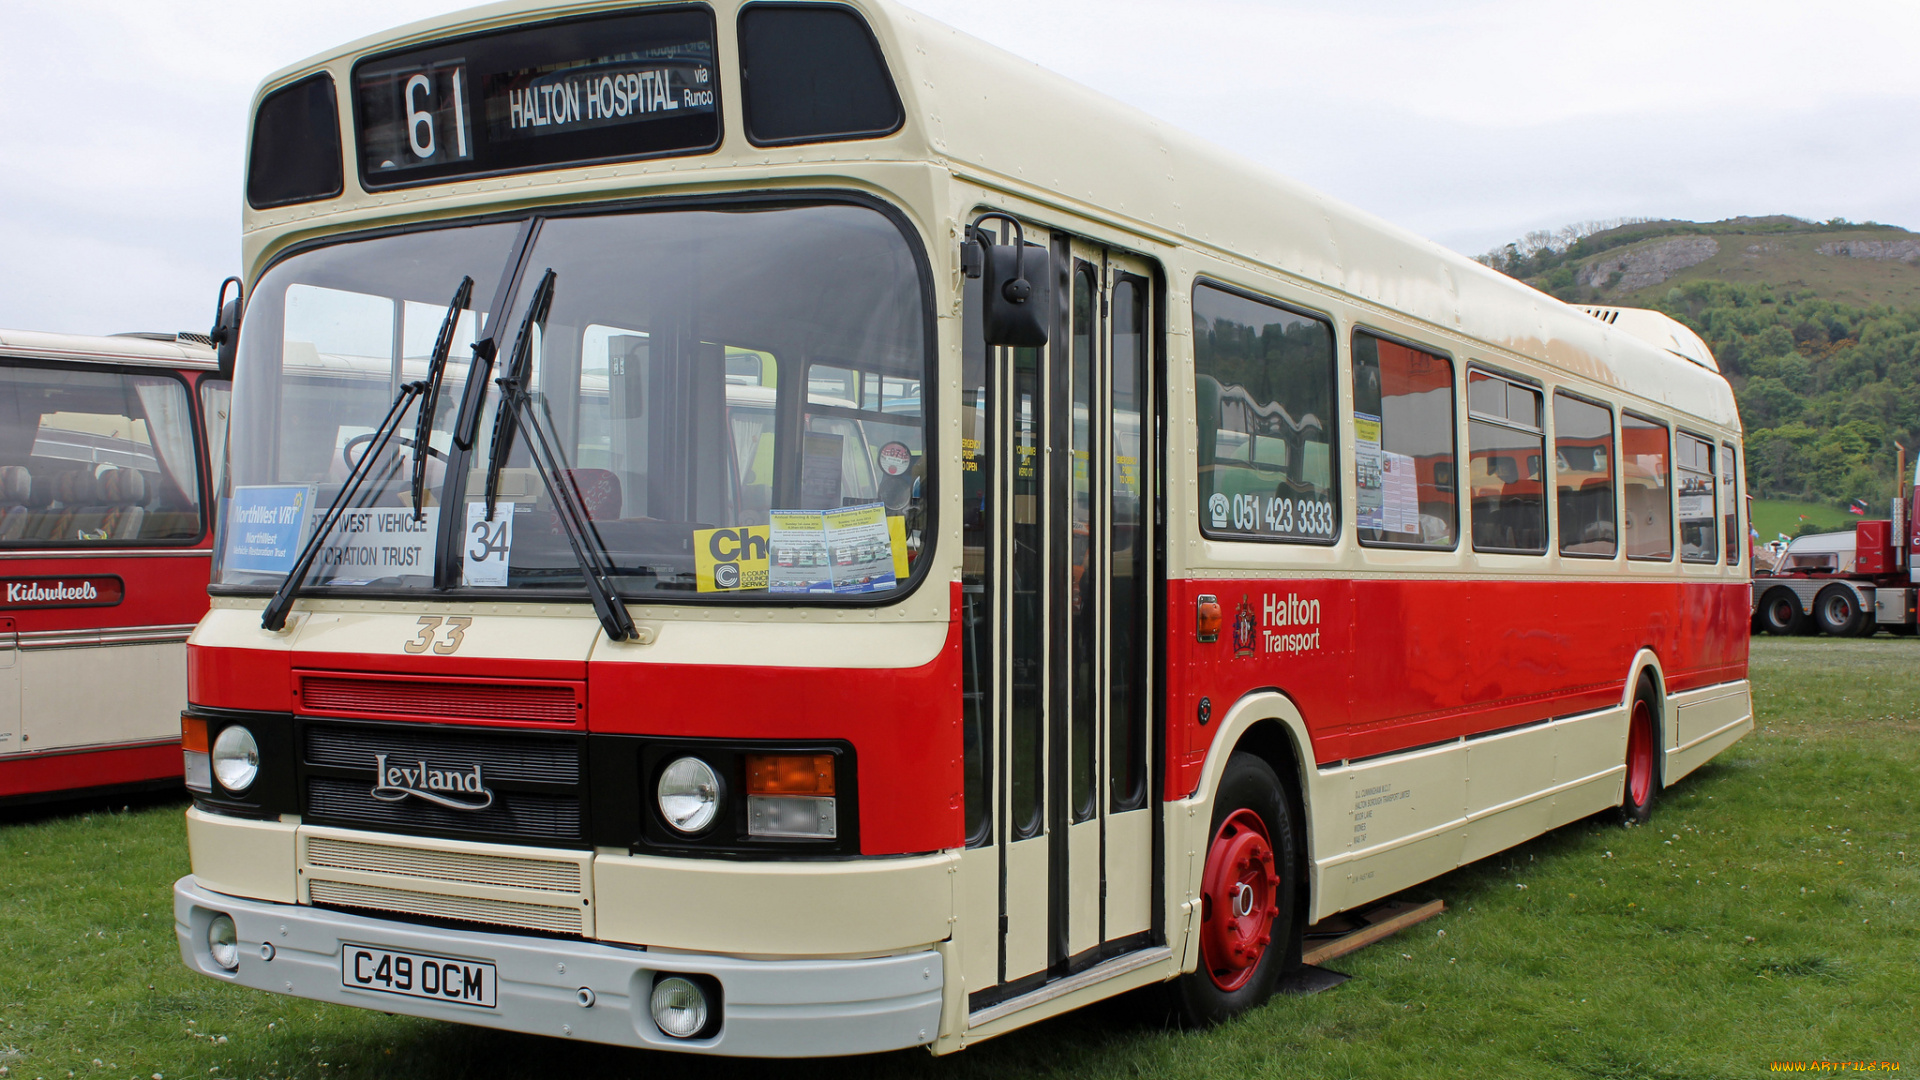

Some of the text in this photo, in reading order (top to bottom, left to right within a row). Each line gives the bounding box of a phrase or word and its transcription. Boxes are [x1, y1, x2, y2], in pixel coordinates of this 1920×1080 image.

[694, 64, 709, 84] via
[509, 68, 679, 129] HALTON HOSPITAL
[233, 505, 299, 525] NorthWest VRT
[340, 513, 373, 533] WEST
[378, 513, 428, 533] VEHICLE
[1233, 493, 1261, 531] 051
[1265, 497, 1294, 533] 423
[1298, 500, 1333, 535] 3333
[382, 546, 422, 566] TRUST
[469, 520, 509, 562] 34
[709, 528, 770, 563] Ch
[6, 581, 98, 602] Kidswheels
[1263, 593, 1320, 626] Halton
[403, 616, 473, 655] 33
[1263, 628, 1320, 656] Transport
[372, 753, 491, 804] Leyland
[354, 951, 483, 1002] C49 OCM
